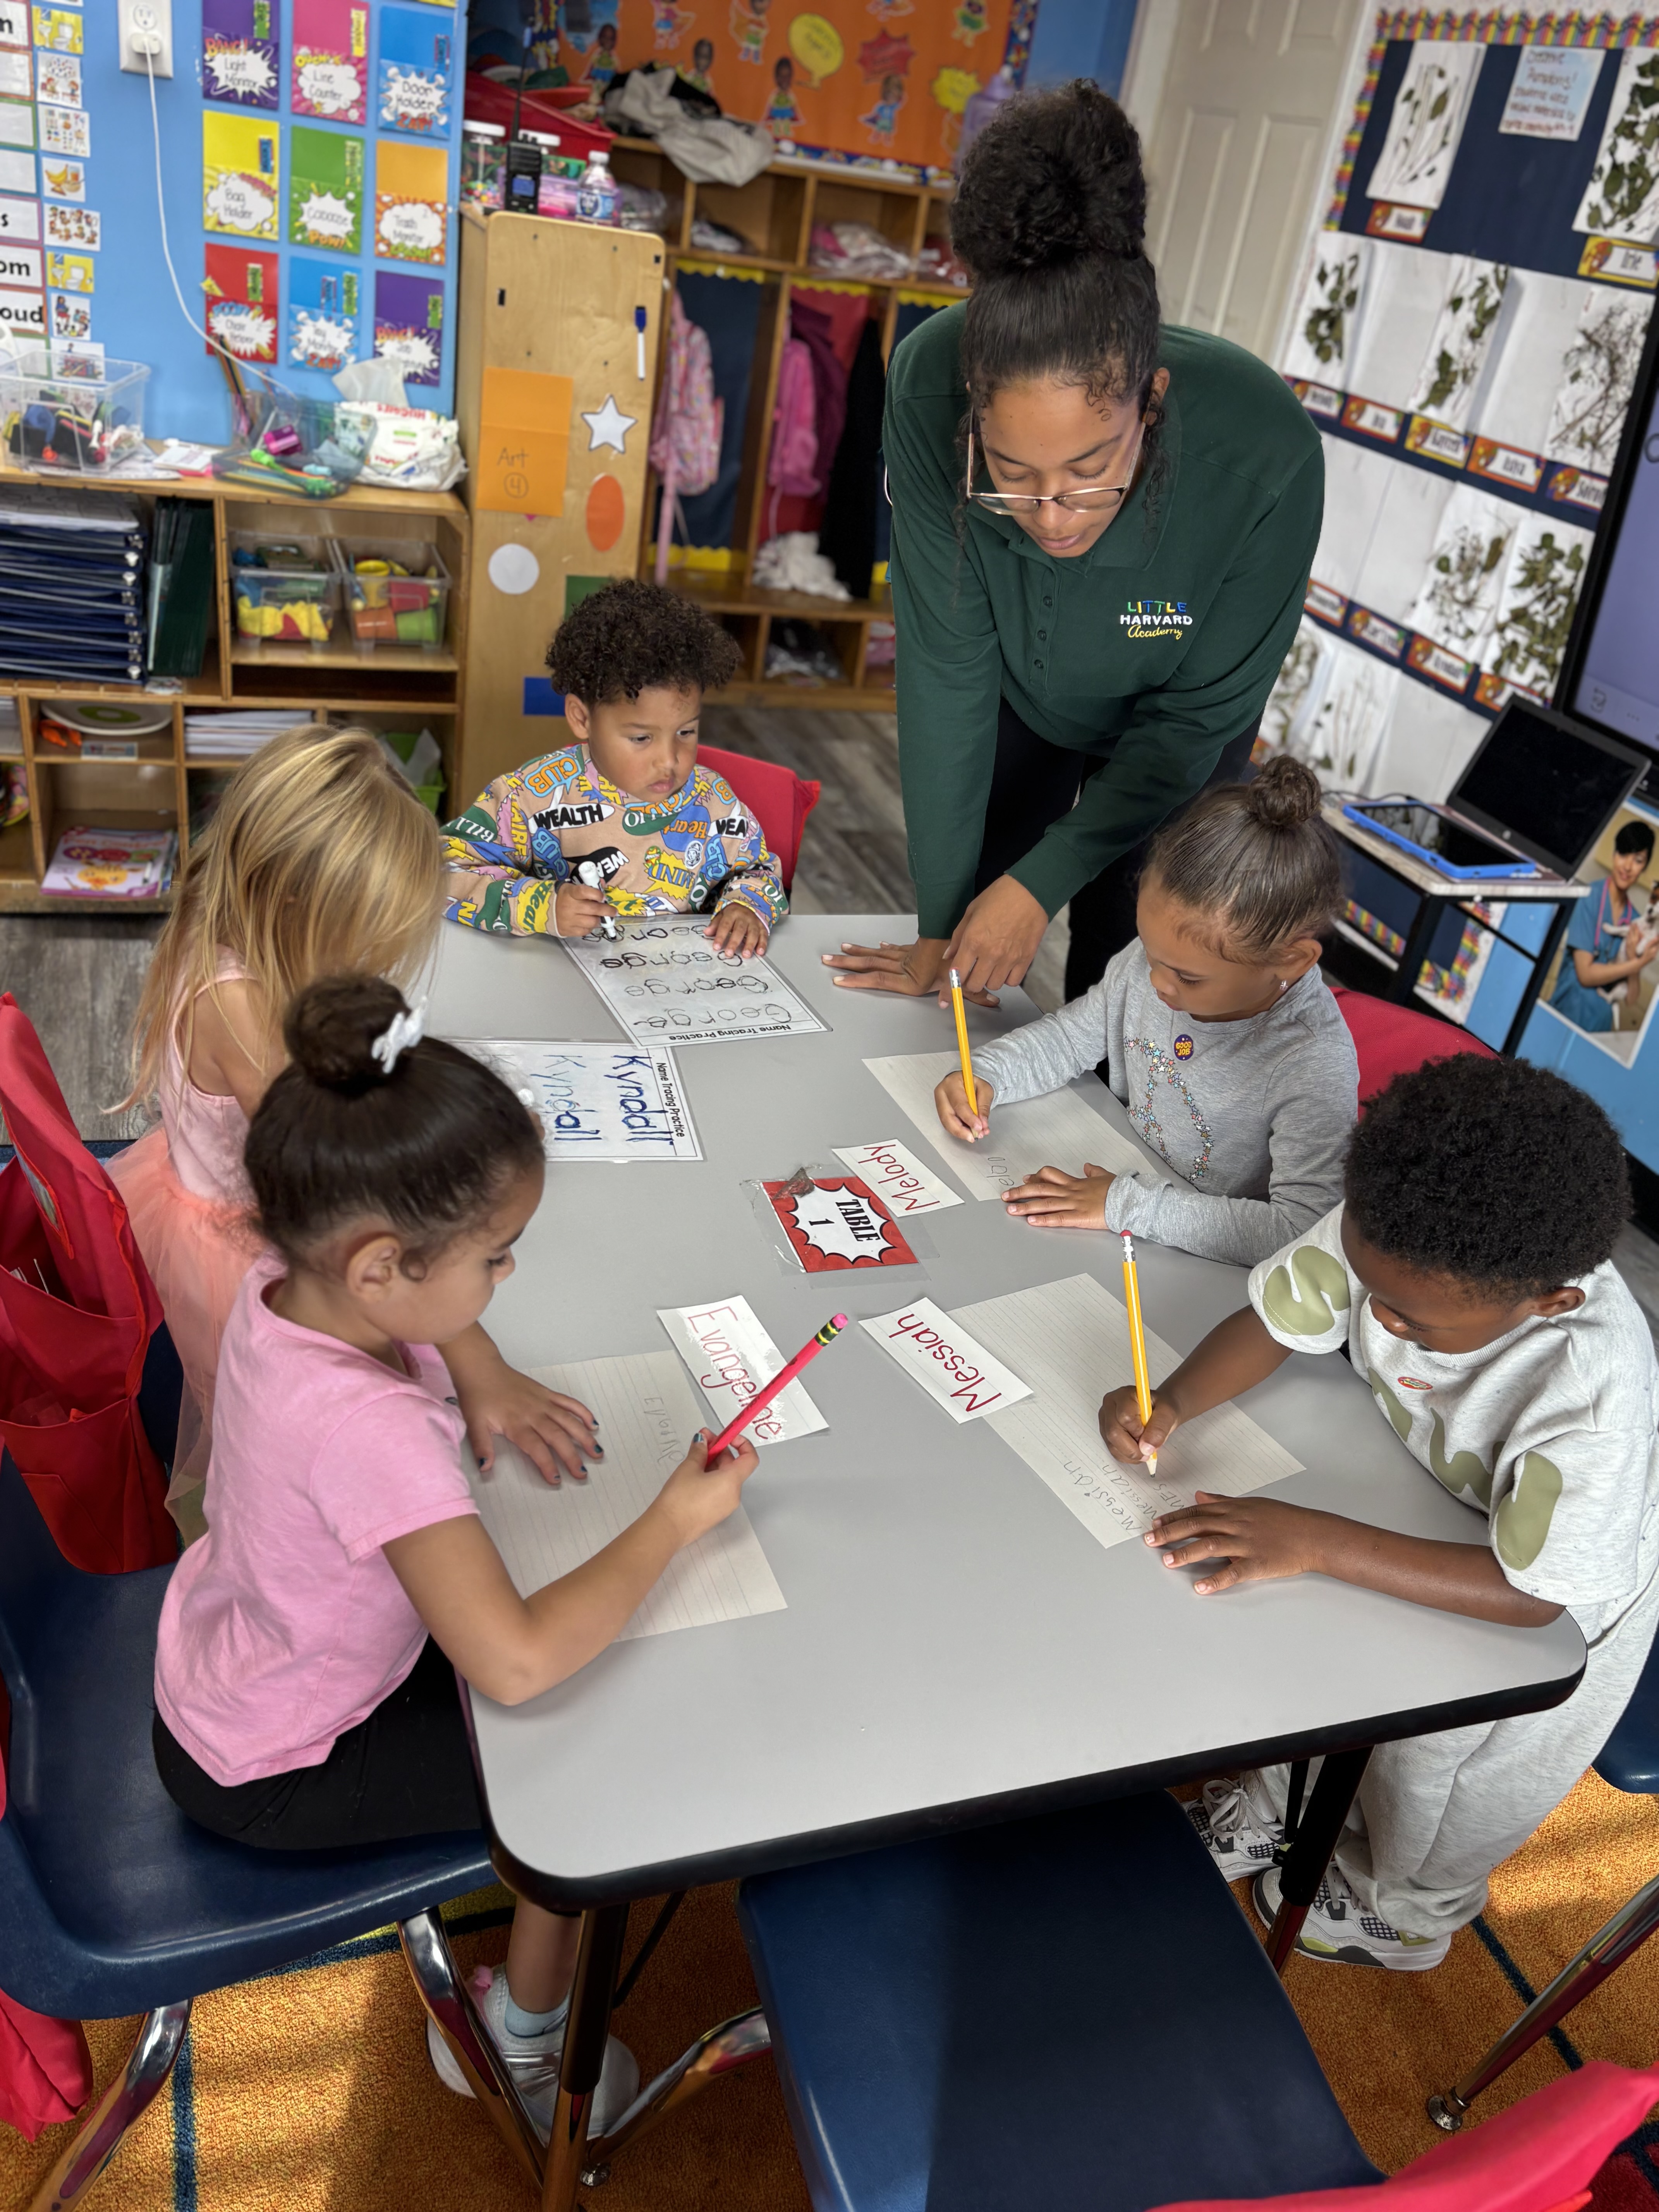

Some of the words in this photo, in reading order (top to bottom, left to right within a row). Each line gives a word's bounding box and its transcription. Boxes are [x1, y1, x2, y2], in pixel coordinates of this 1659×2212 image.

[402, 81, 433, 97] Door
[396, 94, 434, 110] Holder
[225, 188, 246, 209] Bag
[497, 447, 529, 468] Art
[1128, 600, 1187, 615] LITTLE
[1120, 615, 1193, 625] HARVARD
[1128, 624, 1182, 639] Academy
[528, 757, 578, 793] CLUB
[533, 804, 604, 830] WEALTH
[634, 1003, 792, 1028] George
[669, 1031, 716, 1041] Practice
[717, 1027, 759, 1037] Tracing
[656, 1062, 669, 1081] Name
[604, 1054, 675, 1145] Kyndall
[661, 1083, 676, 1107] Tracing
[668, 1108, 685, 1137] Practice
[858, 1144, 940, 1211] Melody
[809, 1218, 835, 1226] 1
[835, 1199, 881, 1243] TABLE
[888, 1313, 1002, 1412] Messiah
